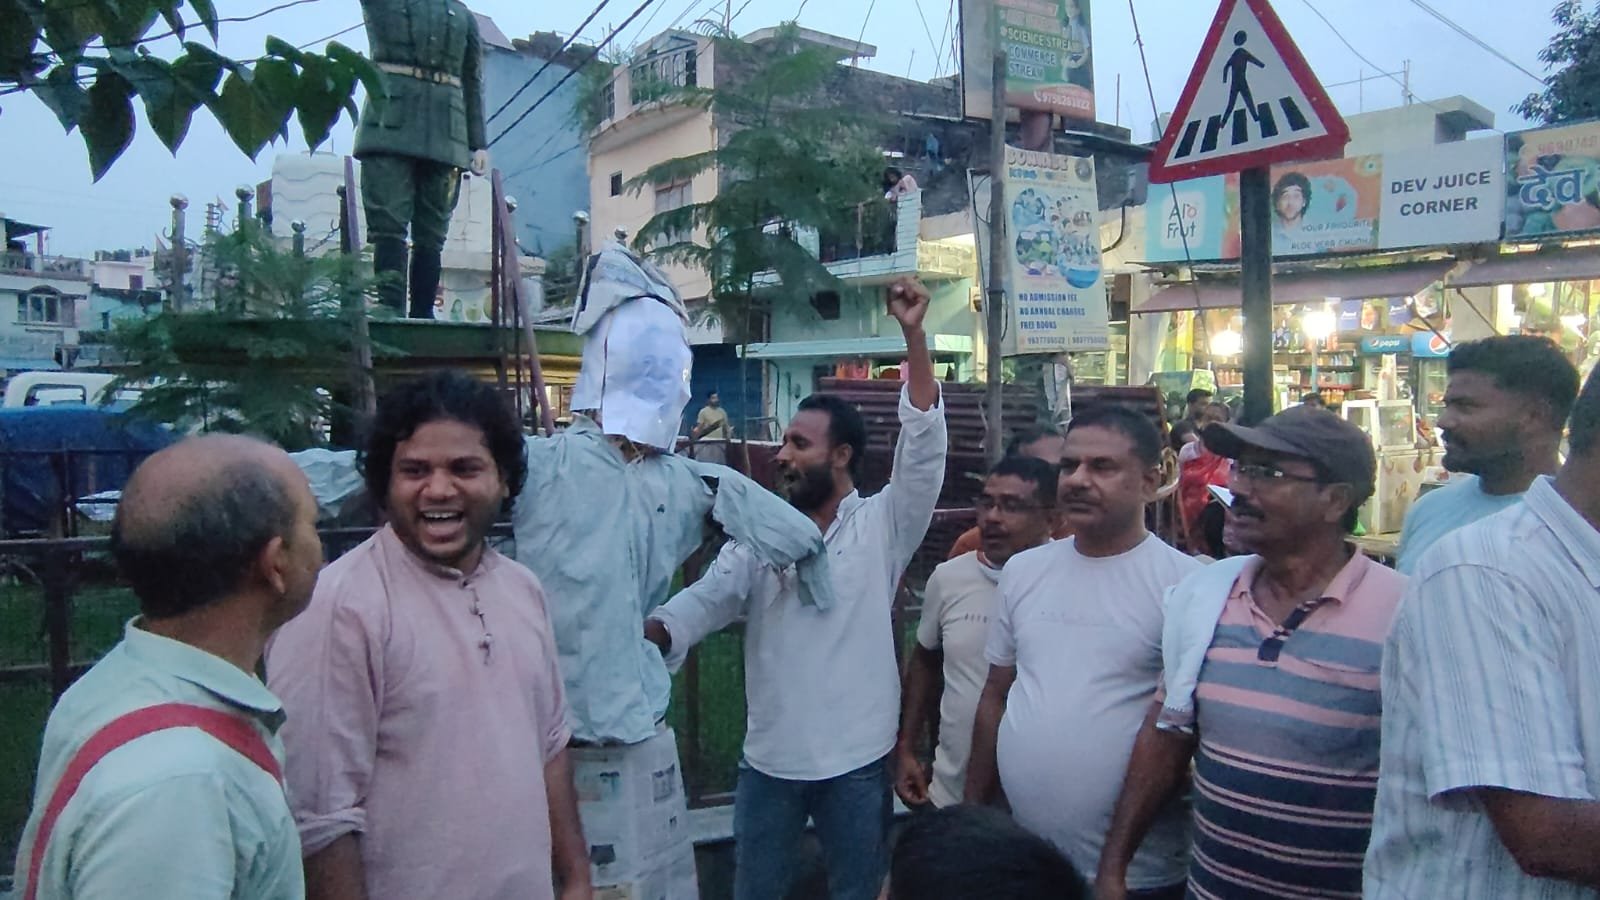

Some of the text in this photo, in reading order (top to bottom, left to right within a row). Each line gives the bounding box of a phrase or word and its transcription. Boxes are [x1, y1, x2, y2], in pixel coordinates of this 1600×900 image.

[1008, 26, 1044, 47] SCIENCE
[1391, 171, 1491, 194] DEV JUICE
[1400, 197, 1478, 216] CORNER
[1167, 221, 1197, 240] Frut
[1302, 223, 1323, 233] YOUR
[1291, 240, 1311, 249] ALOE
[1019, 293, 1028, 302] NO
[1029, 293, 1066, 302] ADMISSION
[1020, 307, 1086, 317] NO ANNUAL CHARGES
[1020, 321, 1057, 330] FREE BOOKS
[1379, 339, 1400, 348] pepsi
